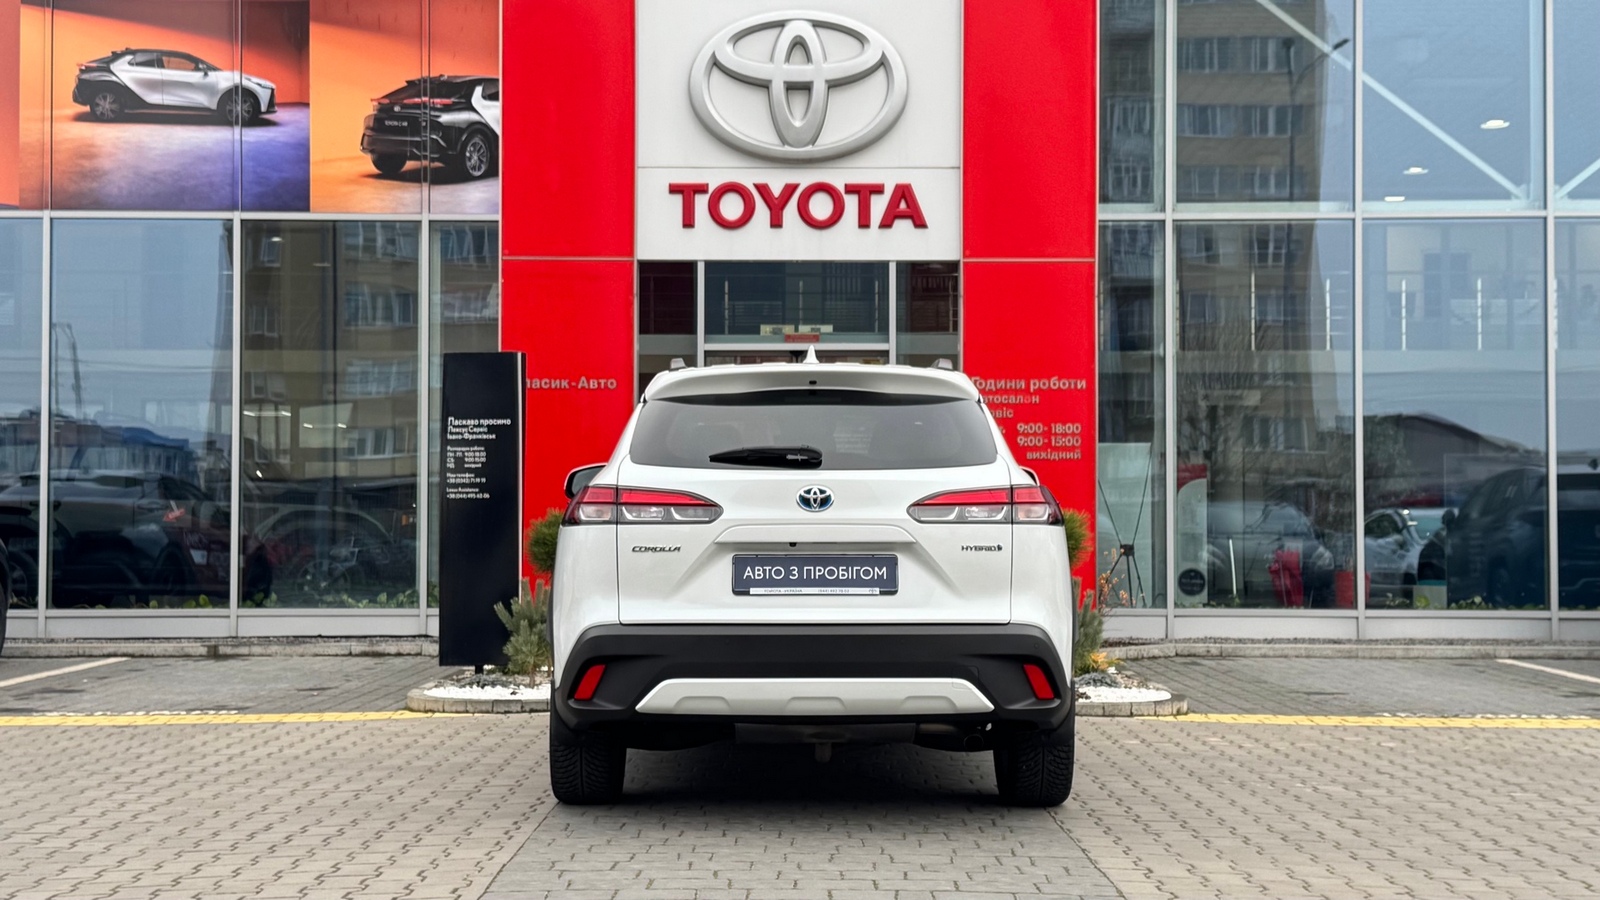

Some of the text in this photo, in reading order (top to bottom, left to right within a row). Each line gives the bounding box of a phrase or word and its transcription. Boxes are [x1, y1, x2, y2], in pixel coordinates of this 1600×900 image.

[668, 181, 929, 230] TOYOTA
[971, 376, 1087, 392] Години роботи
[480, 418, 512, 426] просимо
[1026, 448, 1081, 460] вихідний
[631, 545, 682, 553] COROLLA
[743, 566, 888, 580] АВТО З ПРОБІГОМ
